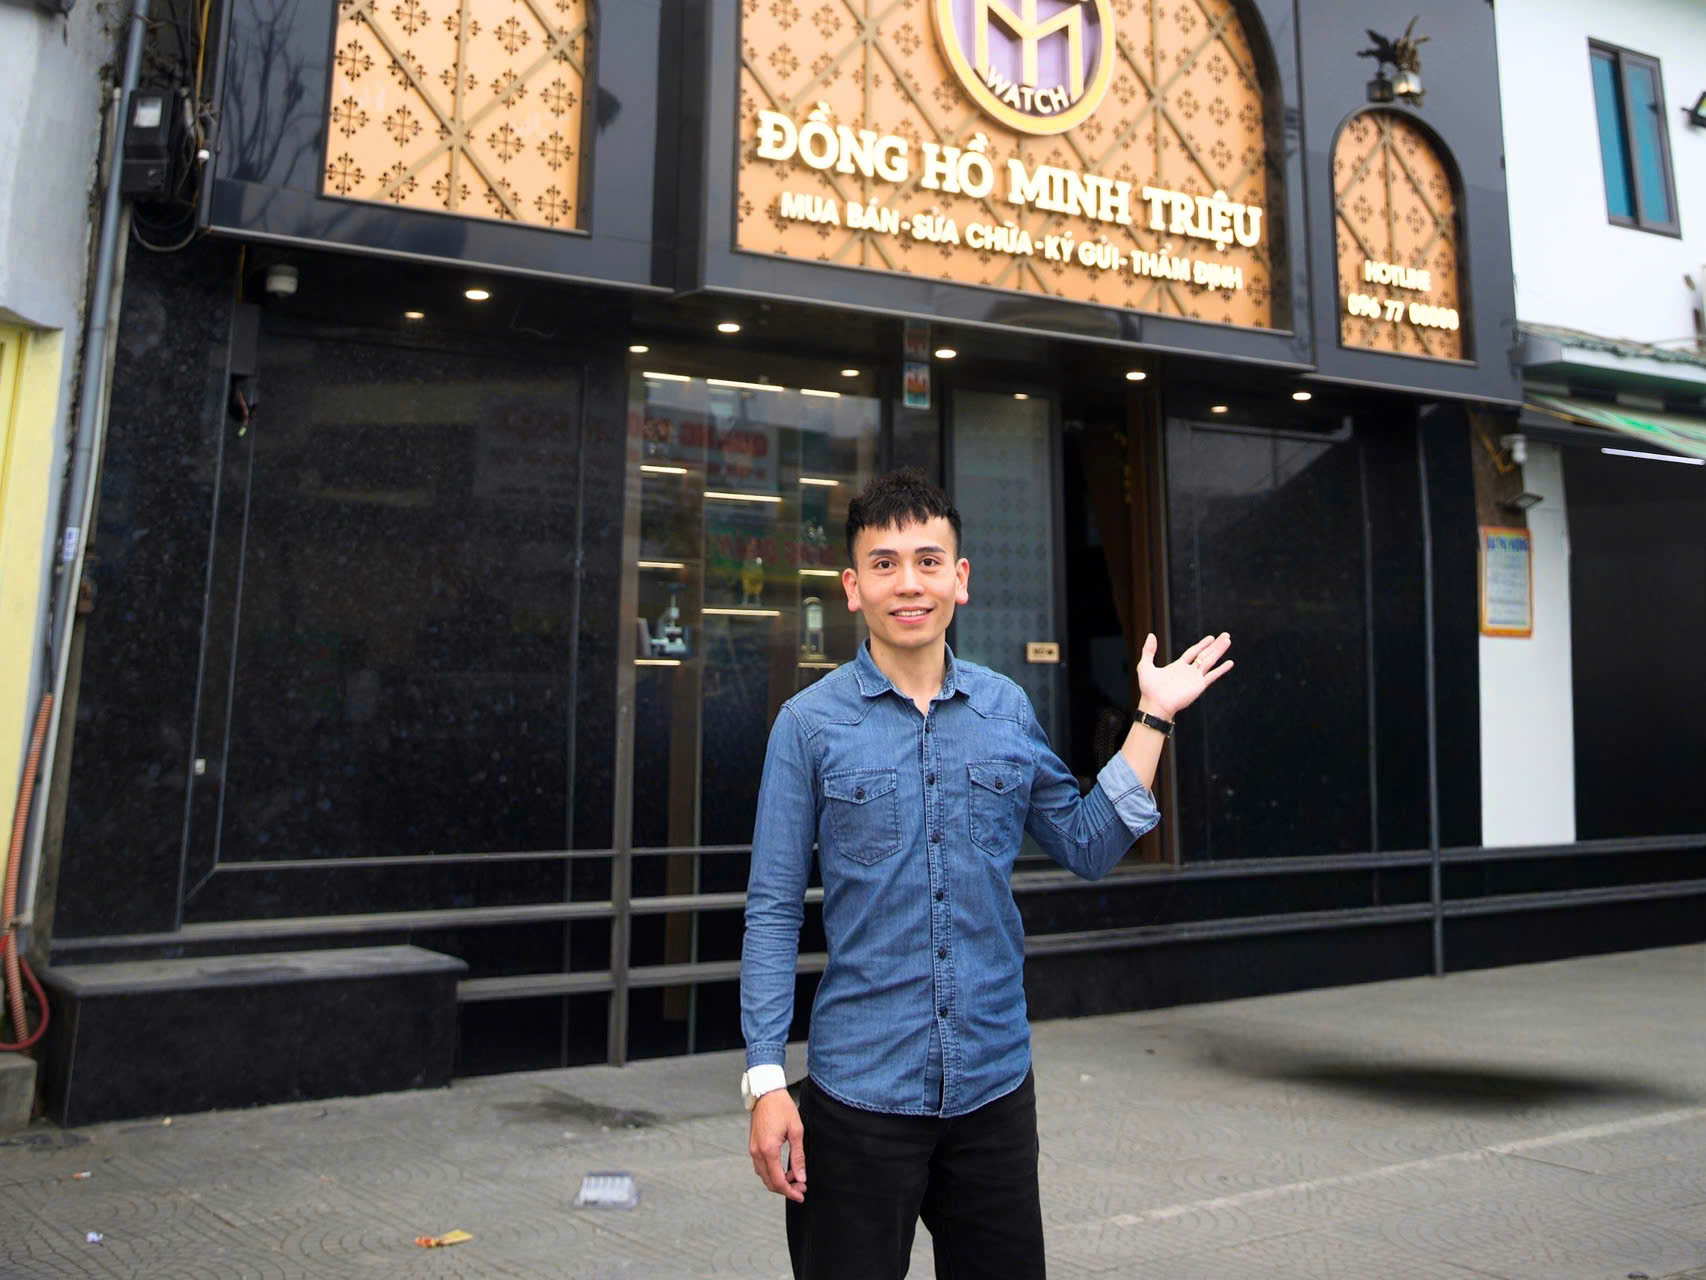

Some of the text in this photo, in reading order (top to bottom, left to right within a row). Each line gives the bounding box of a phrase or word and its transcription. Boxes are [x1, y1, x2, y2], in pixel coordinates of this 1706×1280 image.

[986, 66, 1070, 113] WATCH
[757, 100, 1262, 252] ĐỒNG HỒ MINH TRIỆU
[781, 191, 840, 226] MUA
